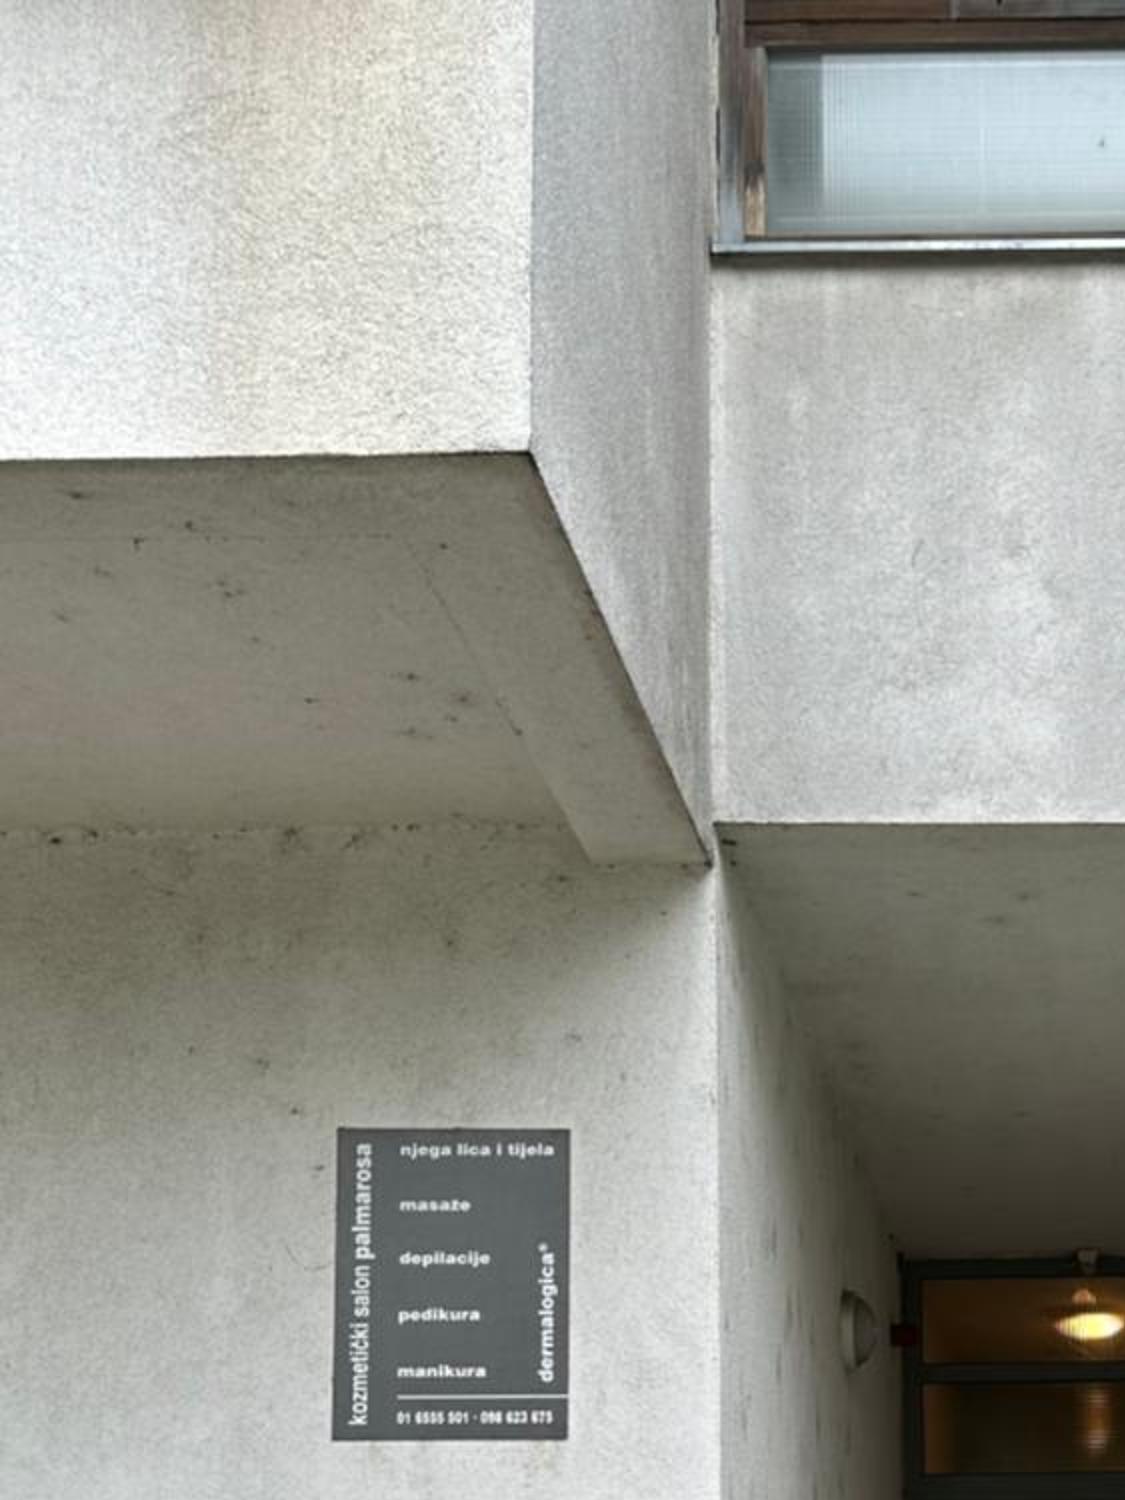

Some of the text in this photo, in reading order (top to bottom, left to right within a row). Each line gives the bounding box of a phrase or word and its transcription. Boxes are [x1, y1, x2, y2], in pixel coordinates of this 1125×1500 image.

[400, 1142, 554, 1160] njega lica i tijela
[399, 1199, 471, 1212] masaže
[399, 1252, 491, 1268] depilacije
[348, 1143, 376, 1425] kozmetički salon palmarosa
[398, 1308, 480, 1323] pedikura
[397, 1365, 487, 1378] manikura
[396, 1411, 410, 1424] 01
